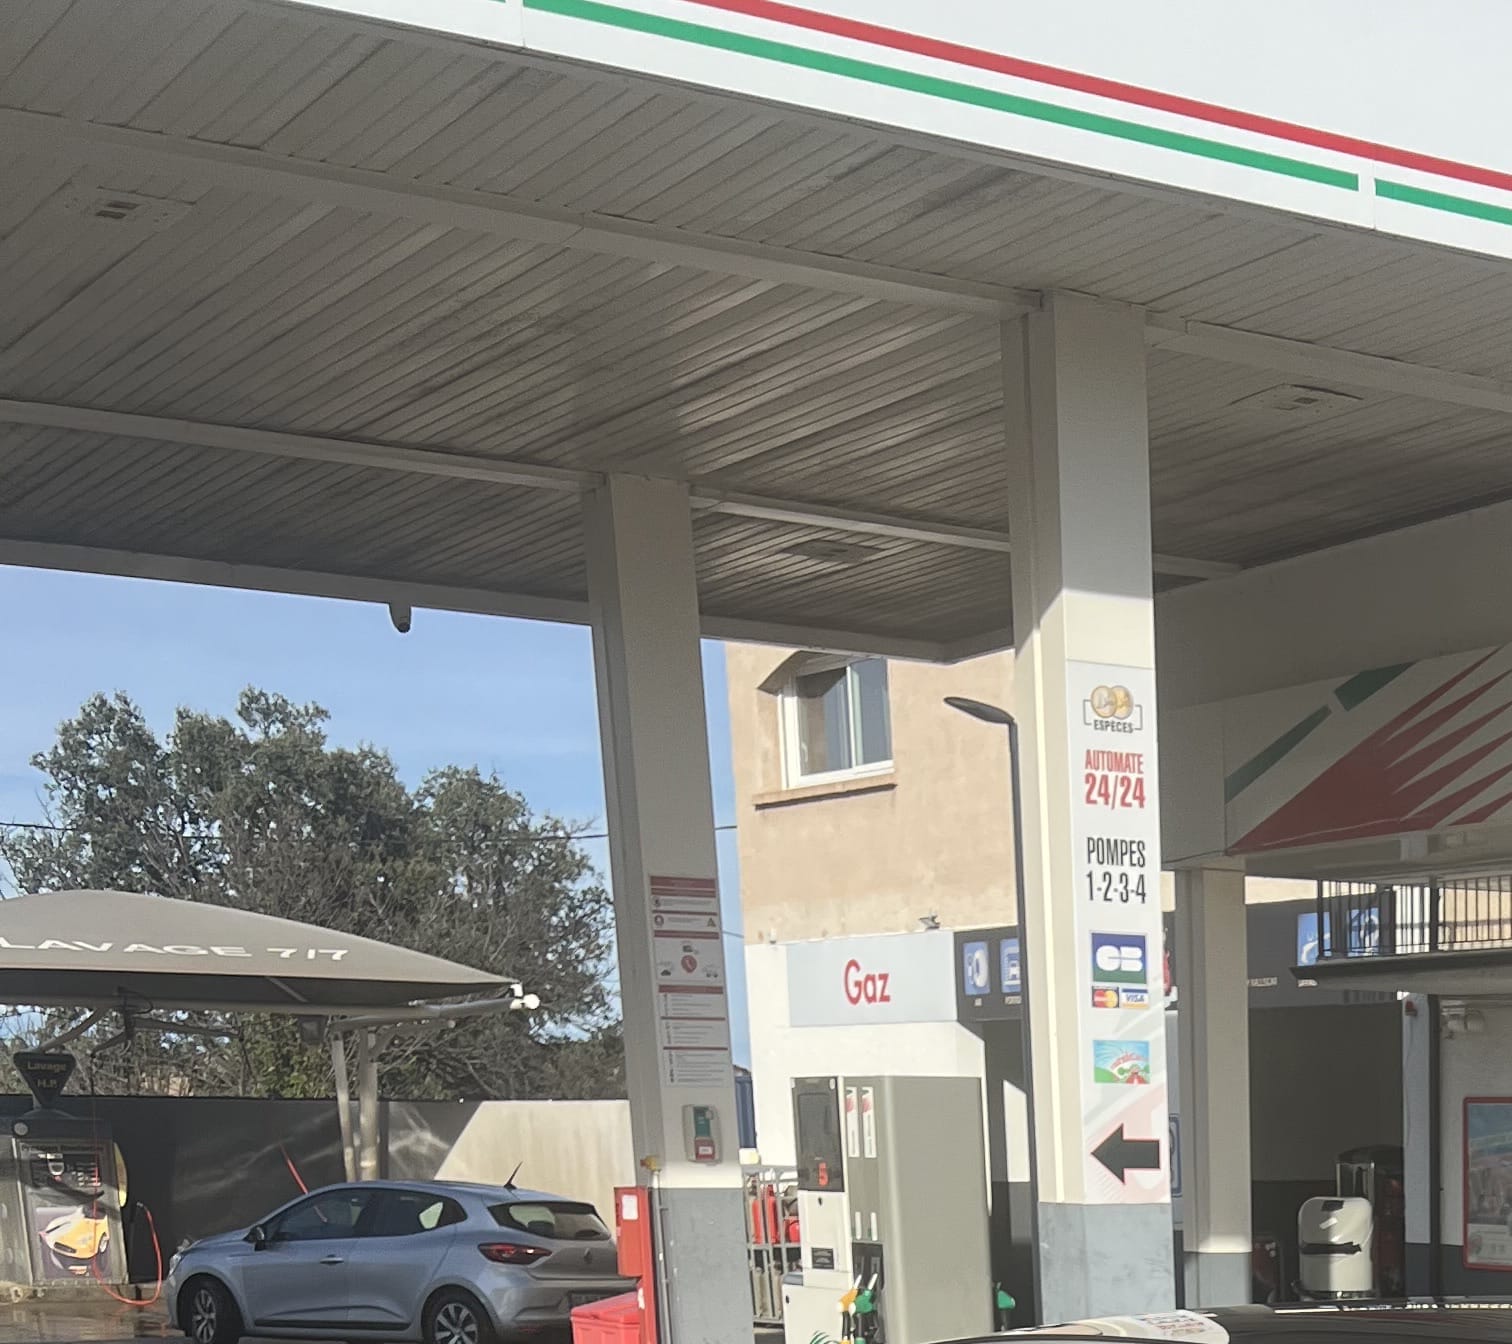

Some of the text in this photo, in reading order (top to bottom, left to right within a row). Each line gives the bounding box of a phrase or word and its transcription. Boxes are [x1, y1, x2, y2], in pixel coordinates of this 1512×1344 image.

[1084, 749, 1144, 775] AUTOMATE
[1085, 773, 1146, 810] 24/24
[1087, 837, 1146, 867] POMPES
[1087, 871, 1147, 904] 1-2-3-4
[0, 937, 252, 957] LAVAGE
[844, 959, 890, 1006] Gaz
[818, 1162, 829, 1187] 5
